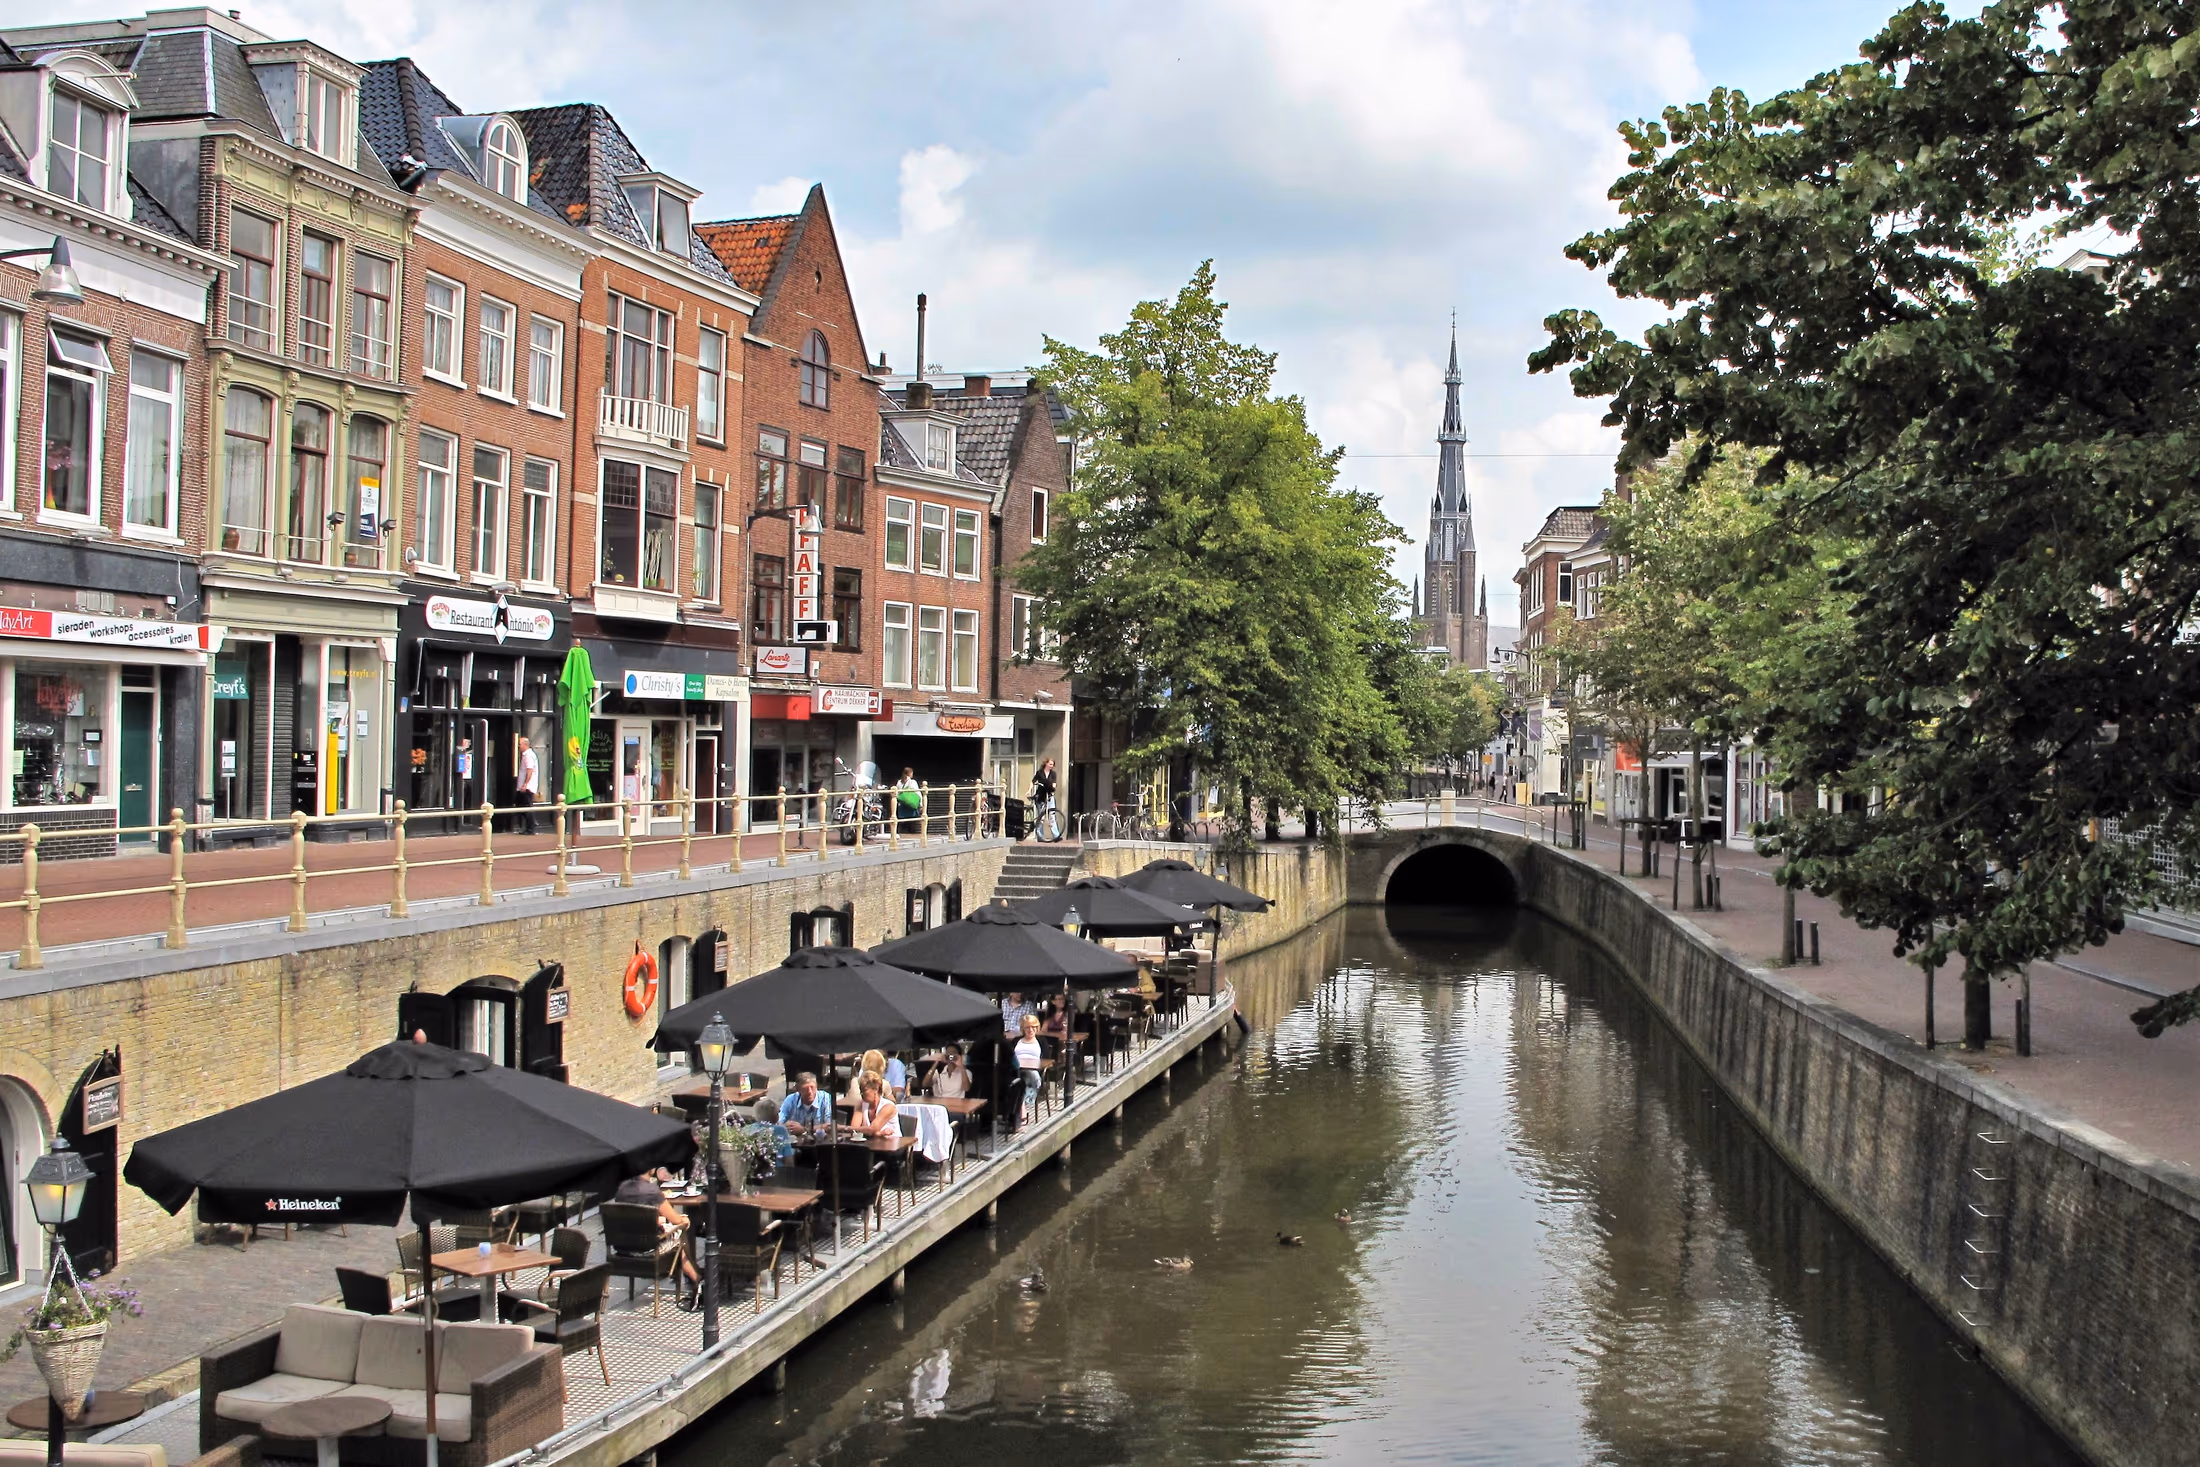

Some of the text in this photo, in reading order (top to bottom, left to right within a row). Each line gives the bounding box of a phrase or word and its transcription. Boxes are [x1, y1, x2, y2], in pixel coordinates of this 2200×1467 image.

[57, 619, 95, 634] sieraden
[449, 609, 493, 628] Restaurant
[90, 622, 134, 638] workshops
[128, 625, 174, 642] accessoires
[169, 633, 193, 645] kralen
[641, 675, 681, 697] Christy's
[278, 1199, 340, 1210] Heineken
